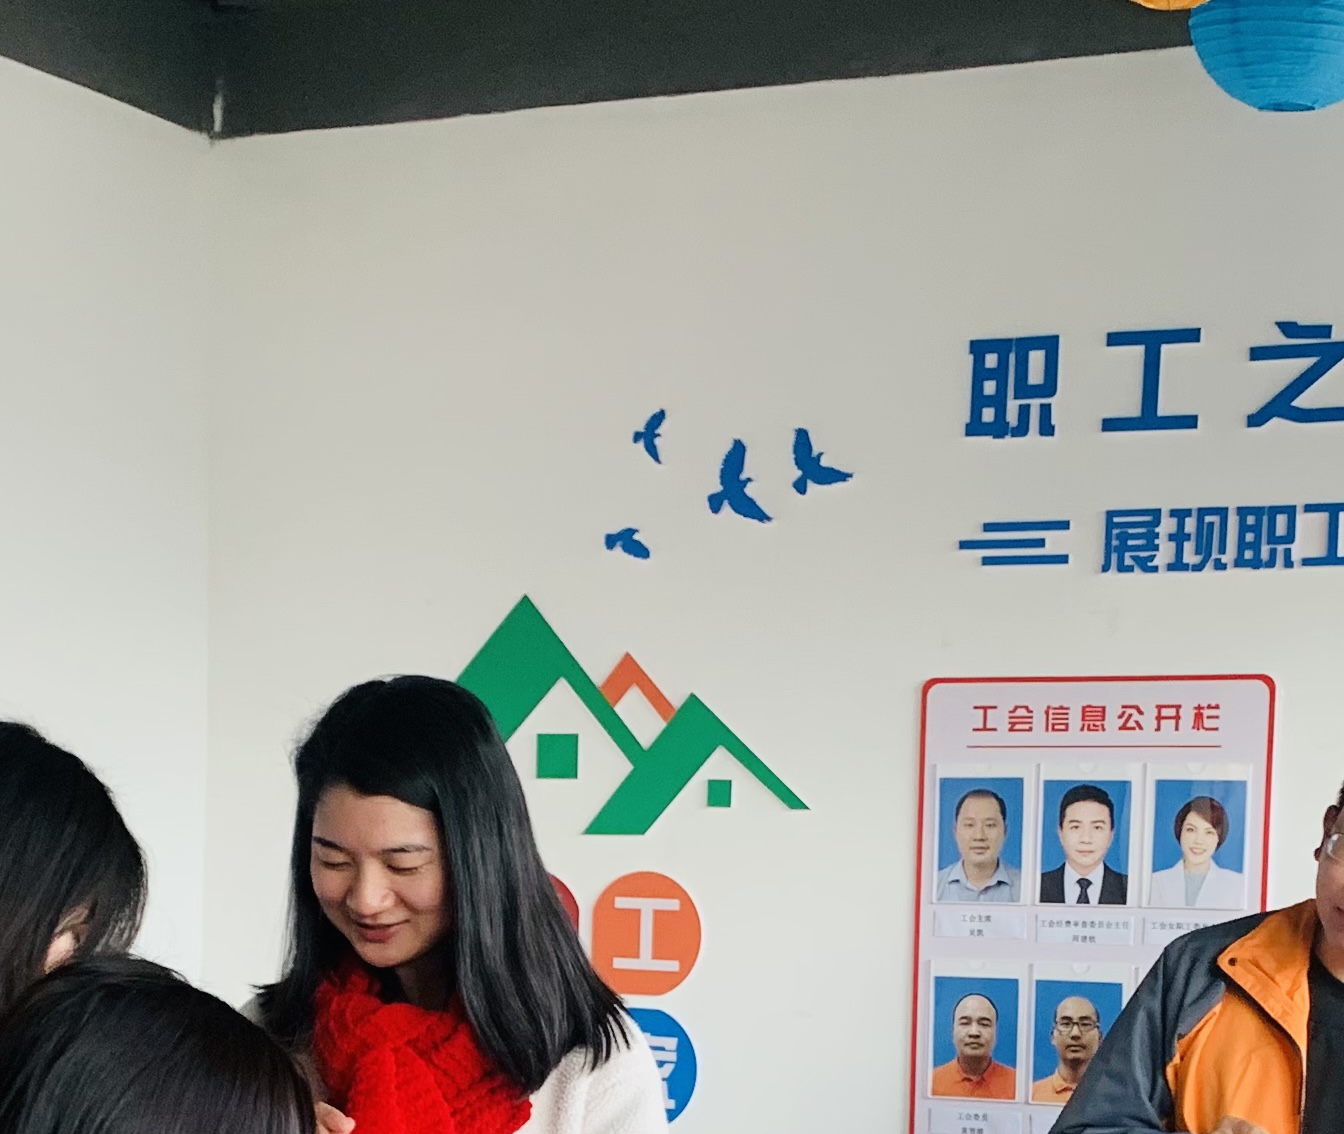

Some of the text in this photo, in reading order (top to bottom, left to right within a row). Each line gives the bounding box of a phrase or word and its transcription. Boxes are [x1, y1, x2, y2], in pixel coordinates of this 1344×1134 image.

[972, 704, 1222, 733] 工会信息公开栏
